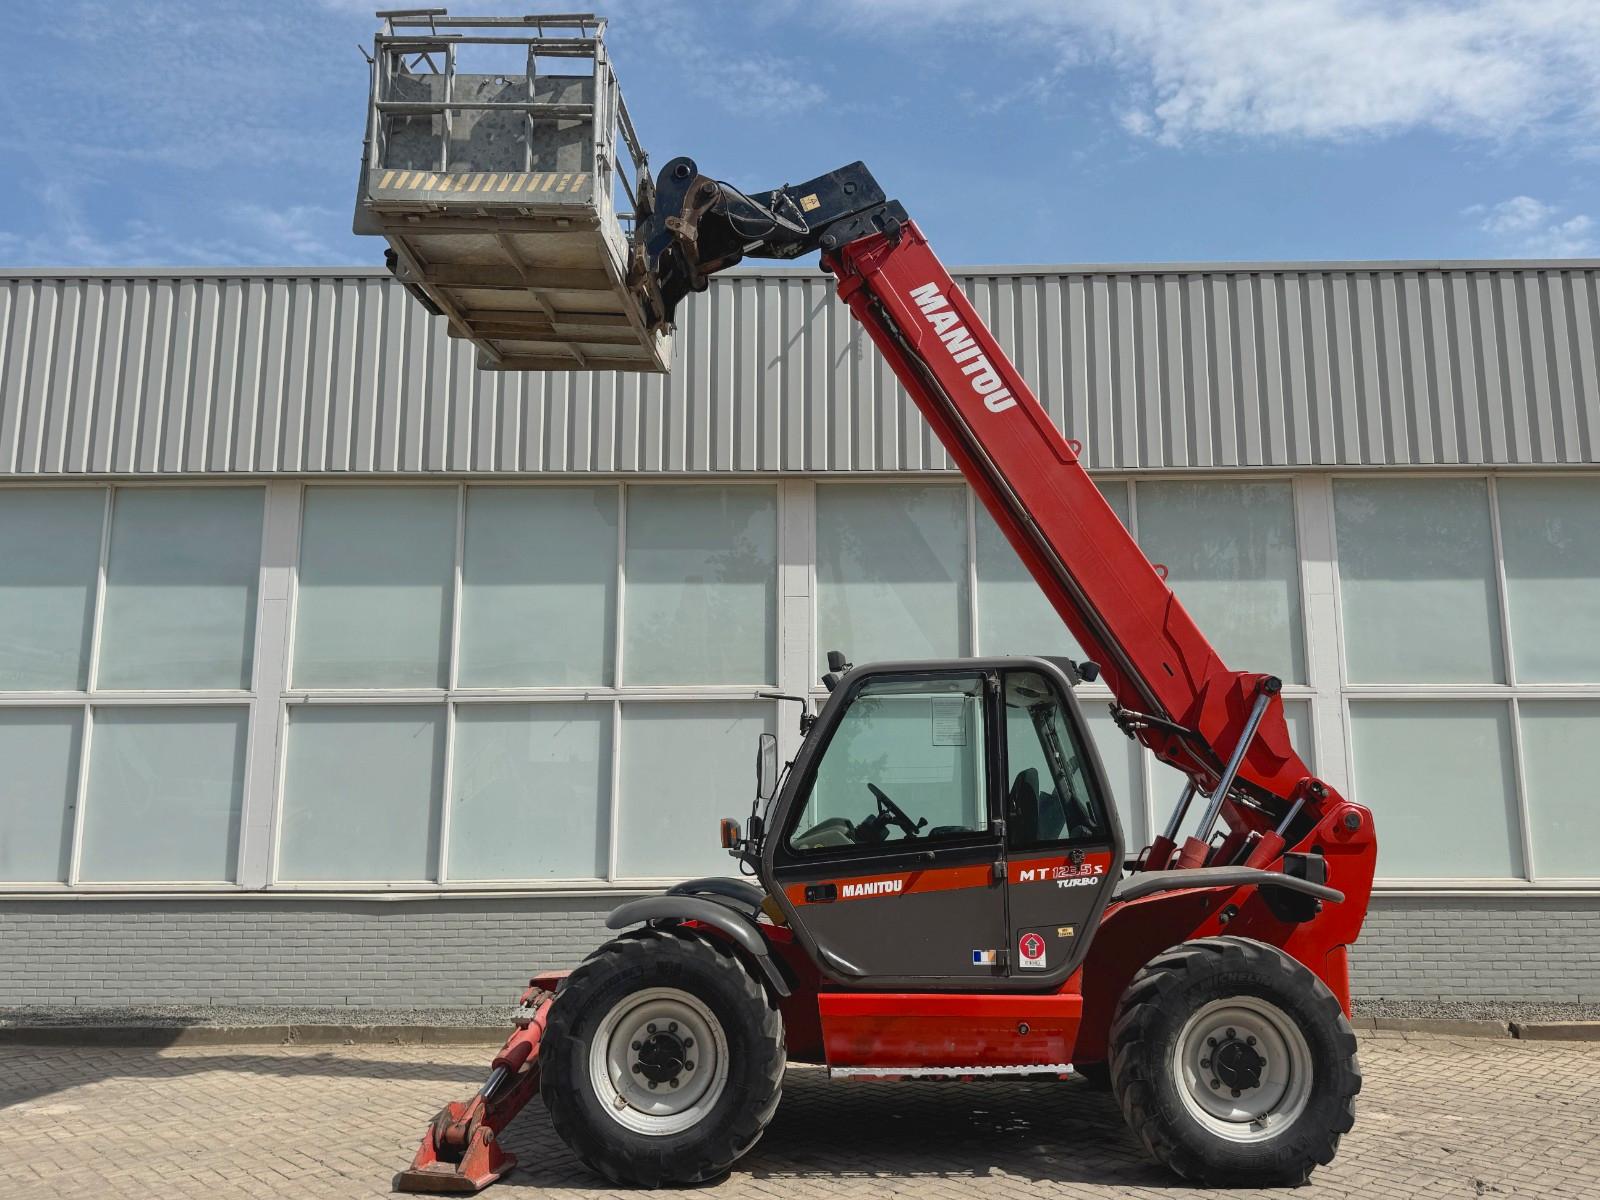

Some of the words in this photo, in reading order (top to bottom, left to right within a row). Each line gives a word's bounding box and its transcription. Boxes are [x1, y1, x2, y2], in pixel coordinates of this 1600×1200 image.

[909, 281, 1018, 413] MANITOU
[1019, 867, 1050, 881] MT
[1056, 876, 1098, 888] TURBO
[842, 879, 903, 897] MANITOU
